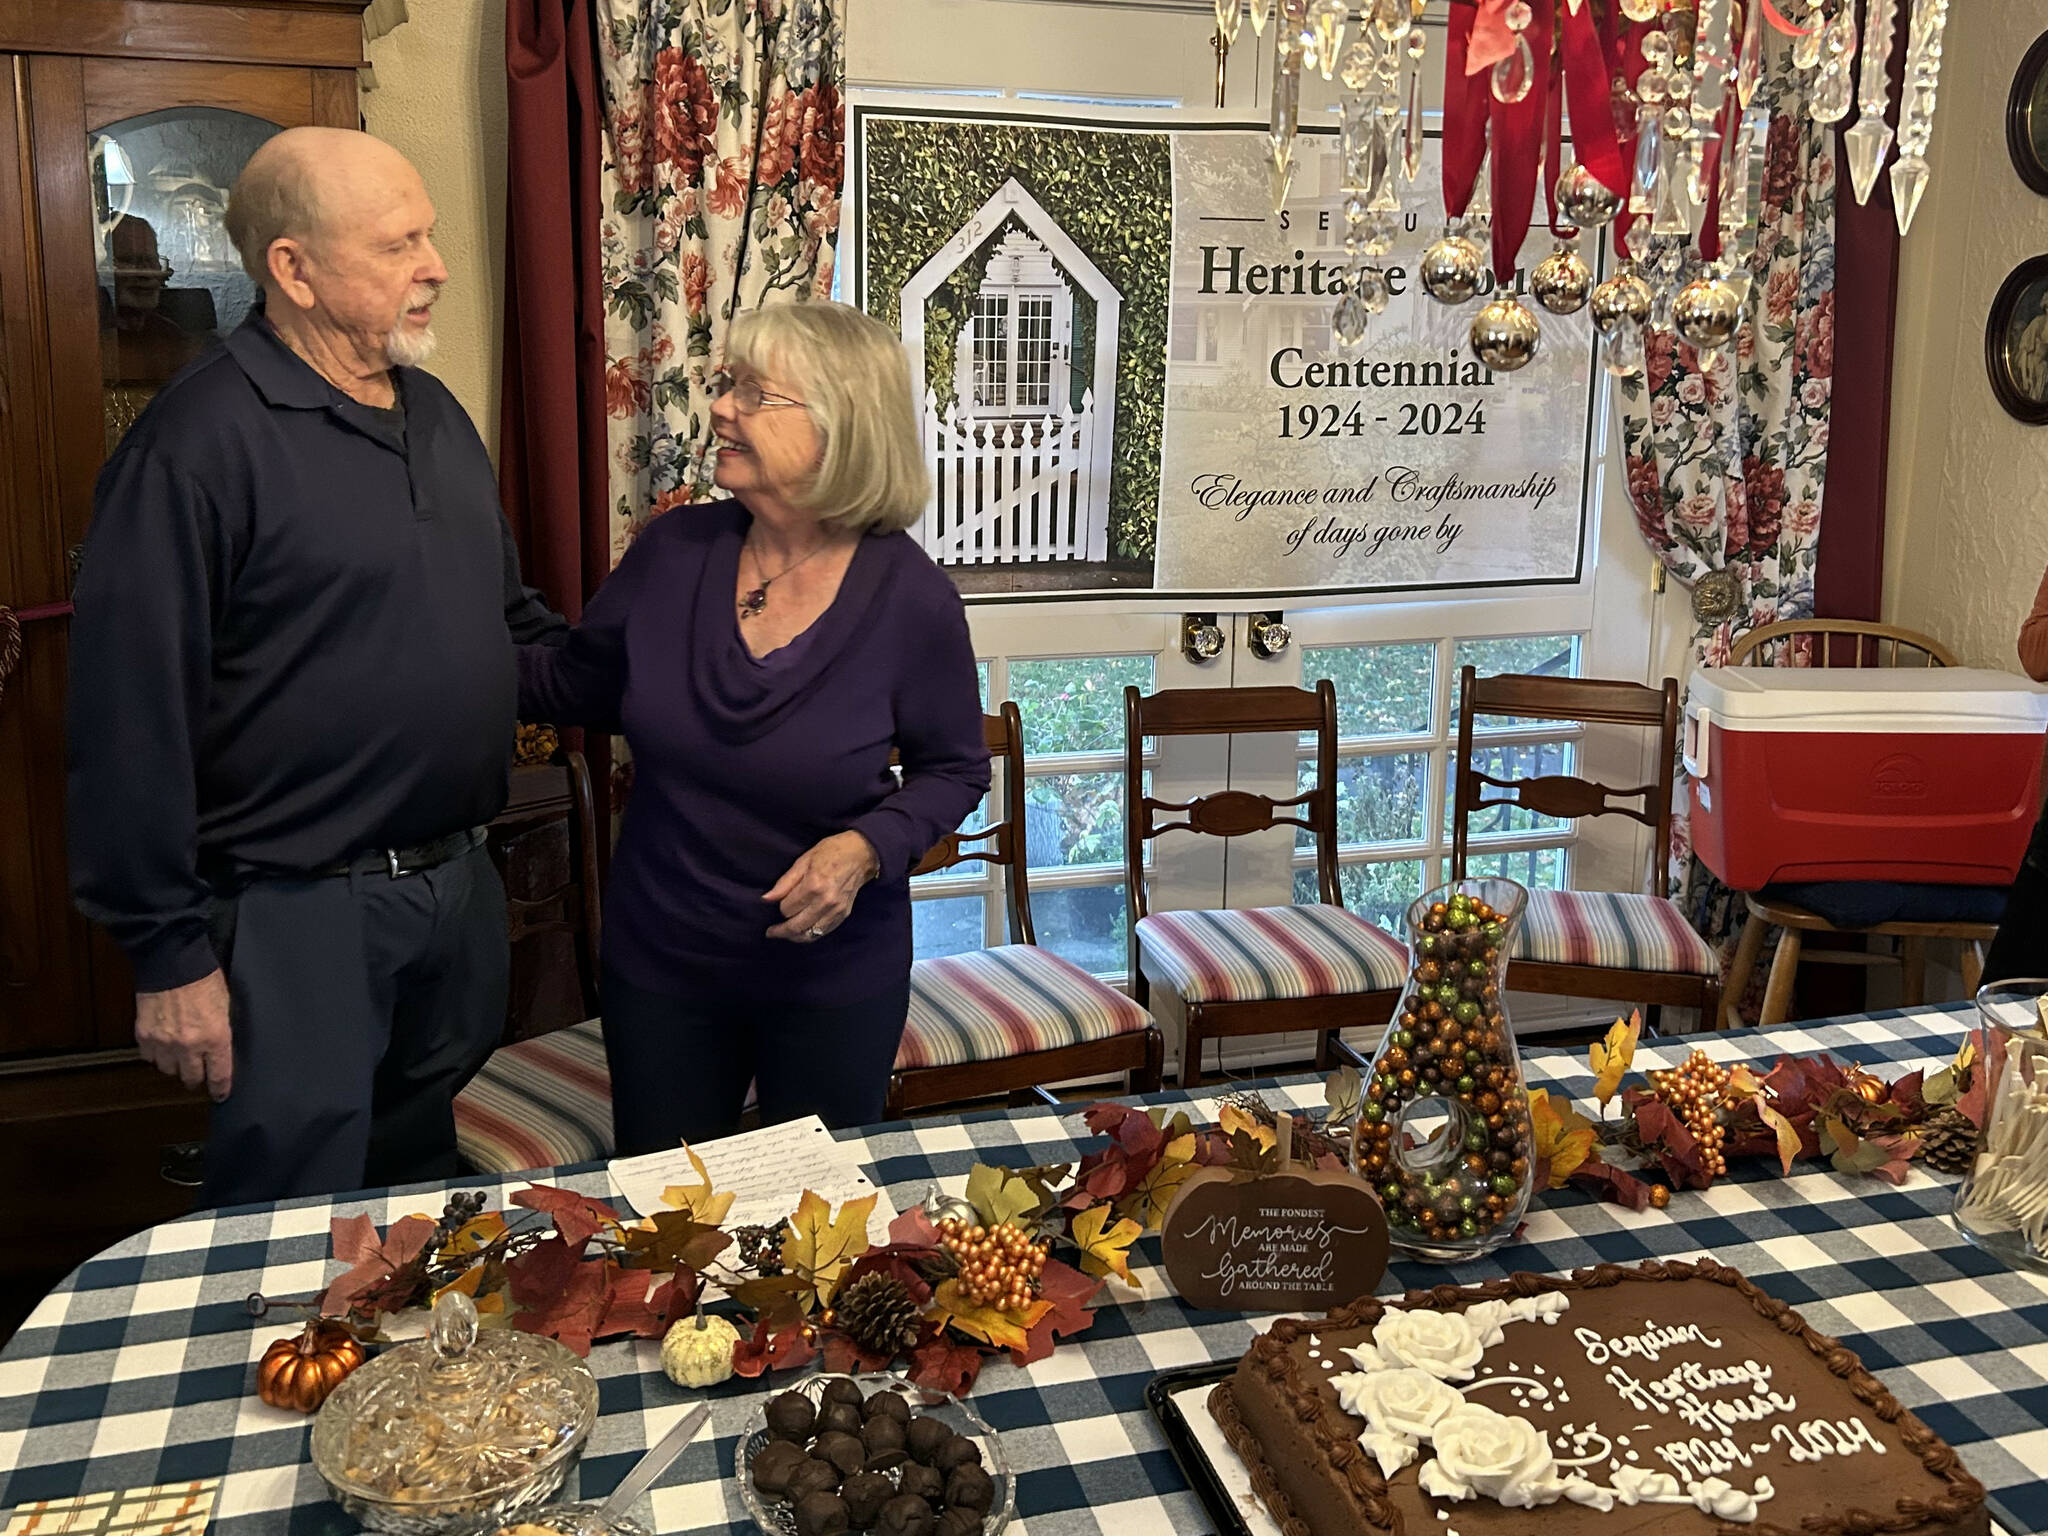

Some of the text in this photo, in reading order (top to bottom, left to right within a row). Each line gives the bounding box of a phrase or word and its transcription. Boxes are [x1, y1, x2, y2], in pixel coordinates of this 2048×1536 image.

[1278, 400, 1365, 440] 1924
[1397, 399, 1487, 436] 2024
[1191, 465, 1557, 522] Elegance and Craftsmanship
[1282, 513, 1464, 559] of days gone by
[1184, 1214, 1369, 1249] Memories
[1259, 1208, 1326, 1218] THE FONDEST
[1258, 1243, 1309, 1253] ARE MADE
[1238, 1280, 1335, 1292] AROUND THE TABLE
[1654, 1437, 1752, 1483] 1924
[1771, 1416, 1887, 1463] 2024
